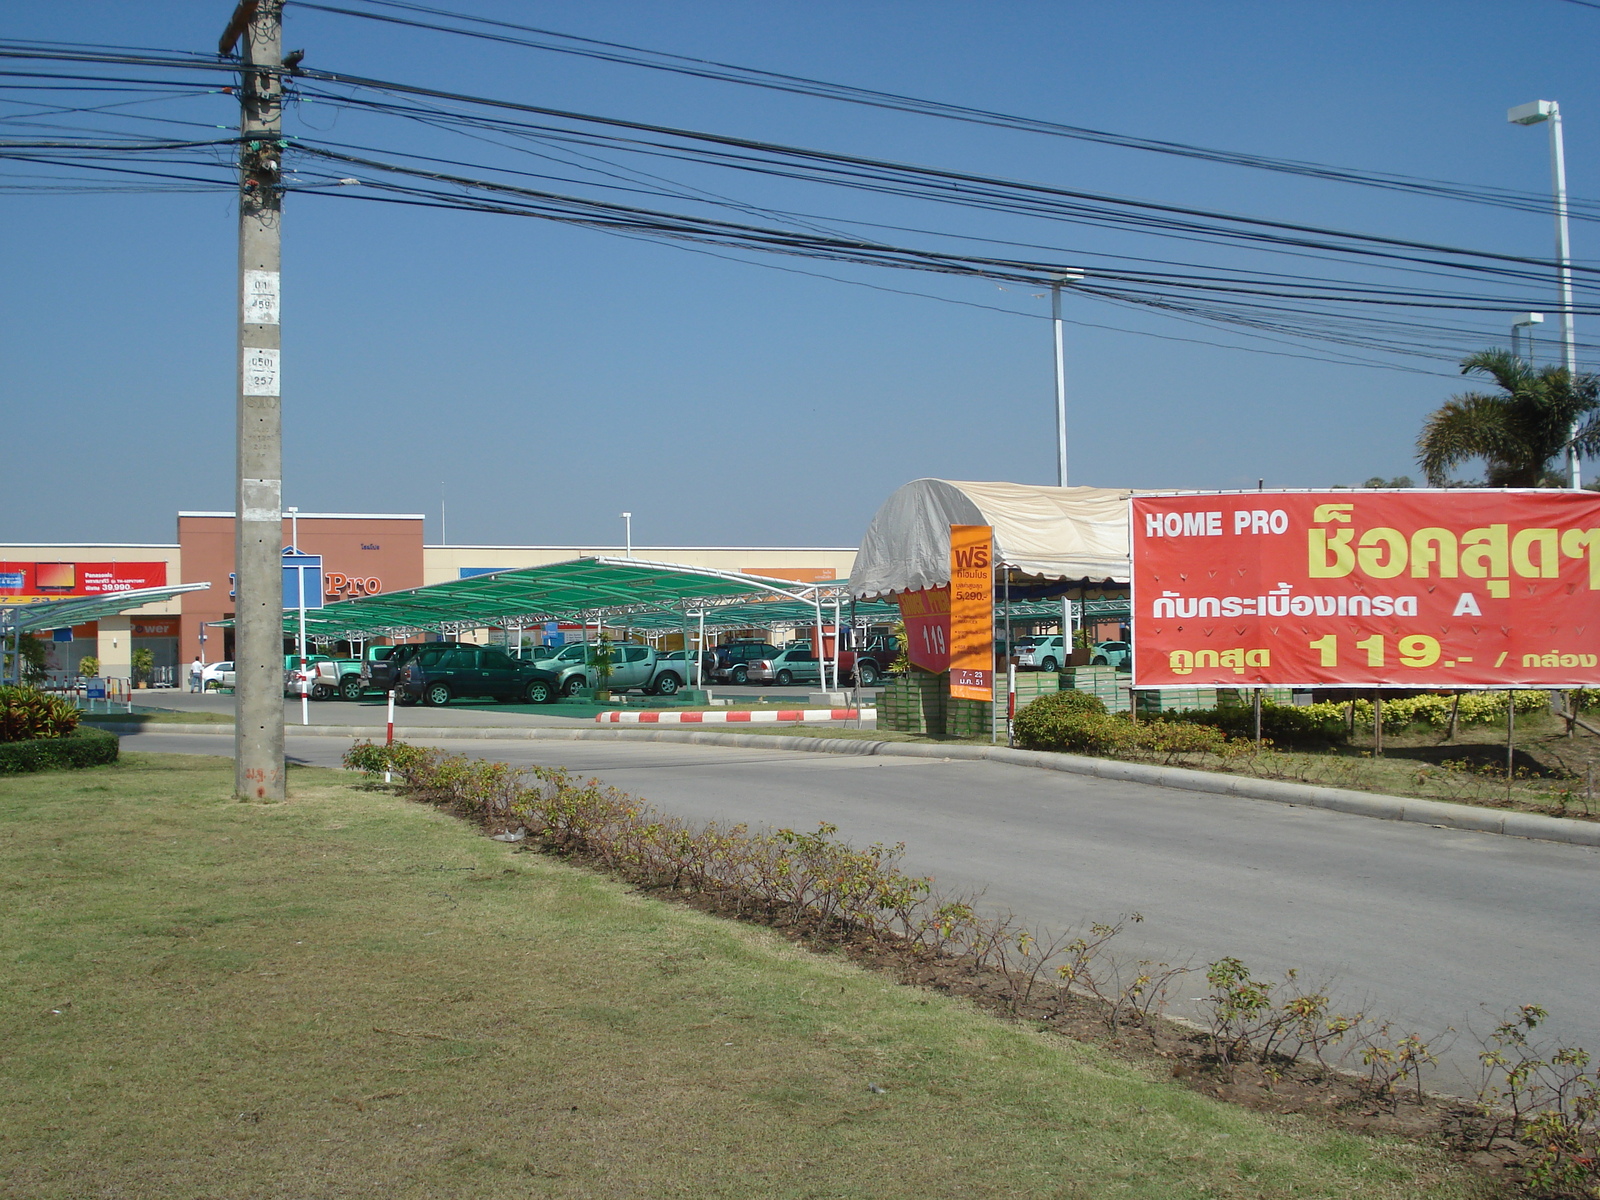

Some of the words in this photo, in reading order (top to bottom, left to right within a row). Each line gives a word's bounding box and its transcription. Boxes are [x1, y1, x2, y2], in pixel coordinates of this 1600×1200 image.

[254, 377, 274, 385] 257
[1146, 512, 1222, 537] HOME
[1235, 509, 1289, 535] PRO
[955, 545, 988, 568] ฟรี
[326, 573, 381, 595] Pro
[956, 591, 988, 601] 5,290.-
[1153, 582, 1418, 618] กับกระเบื้องเกรด
[1453, 592, 1482, 617] A
[923, 625, 946, 654] 119
[1169, 648, 1271, 674] ถูกสุด
[1522, 650, 1598, 668] กล่อง
